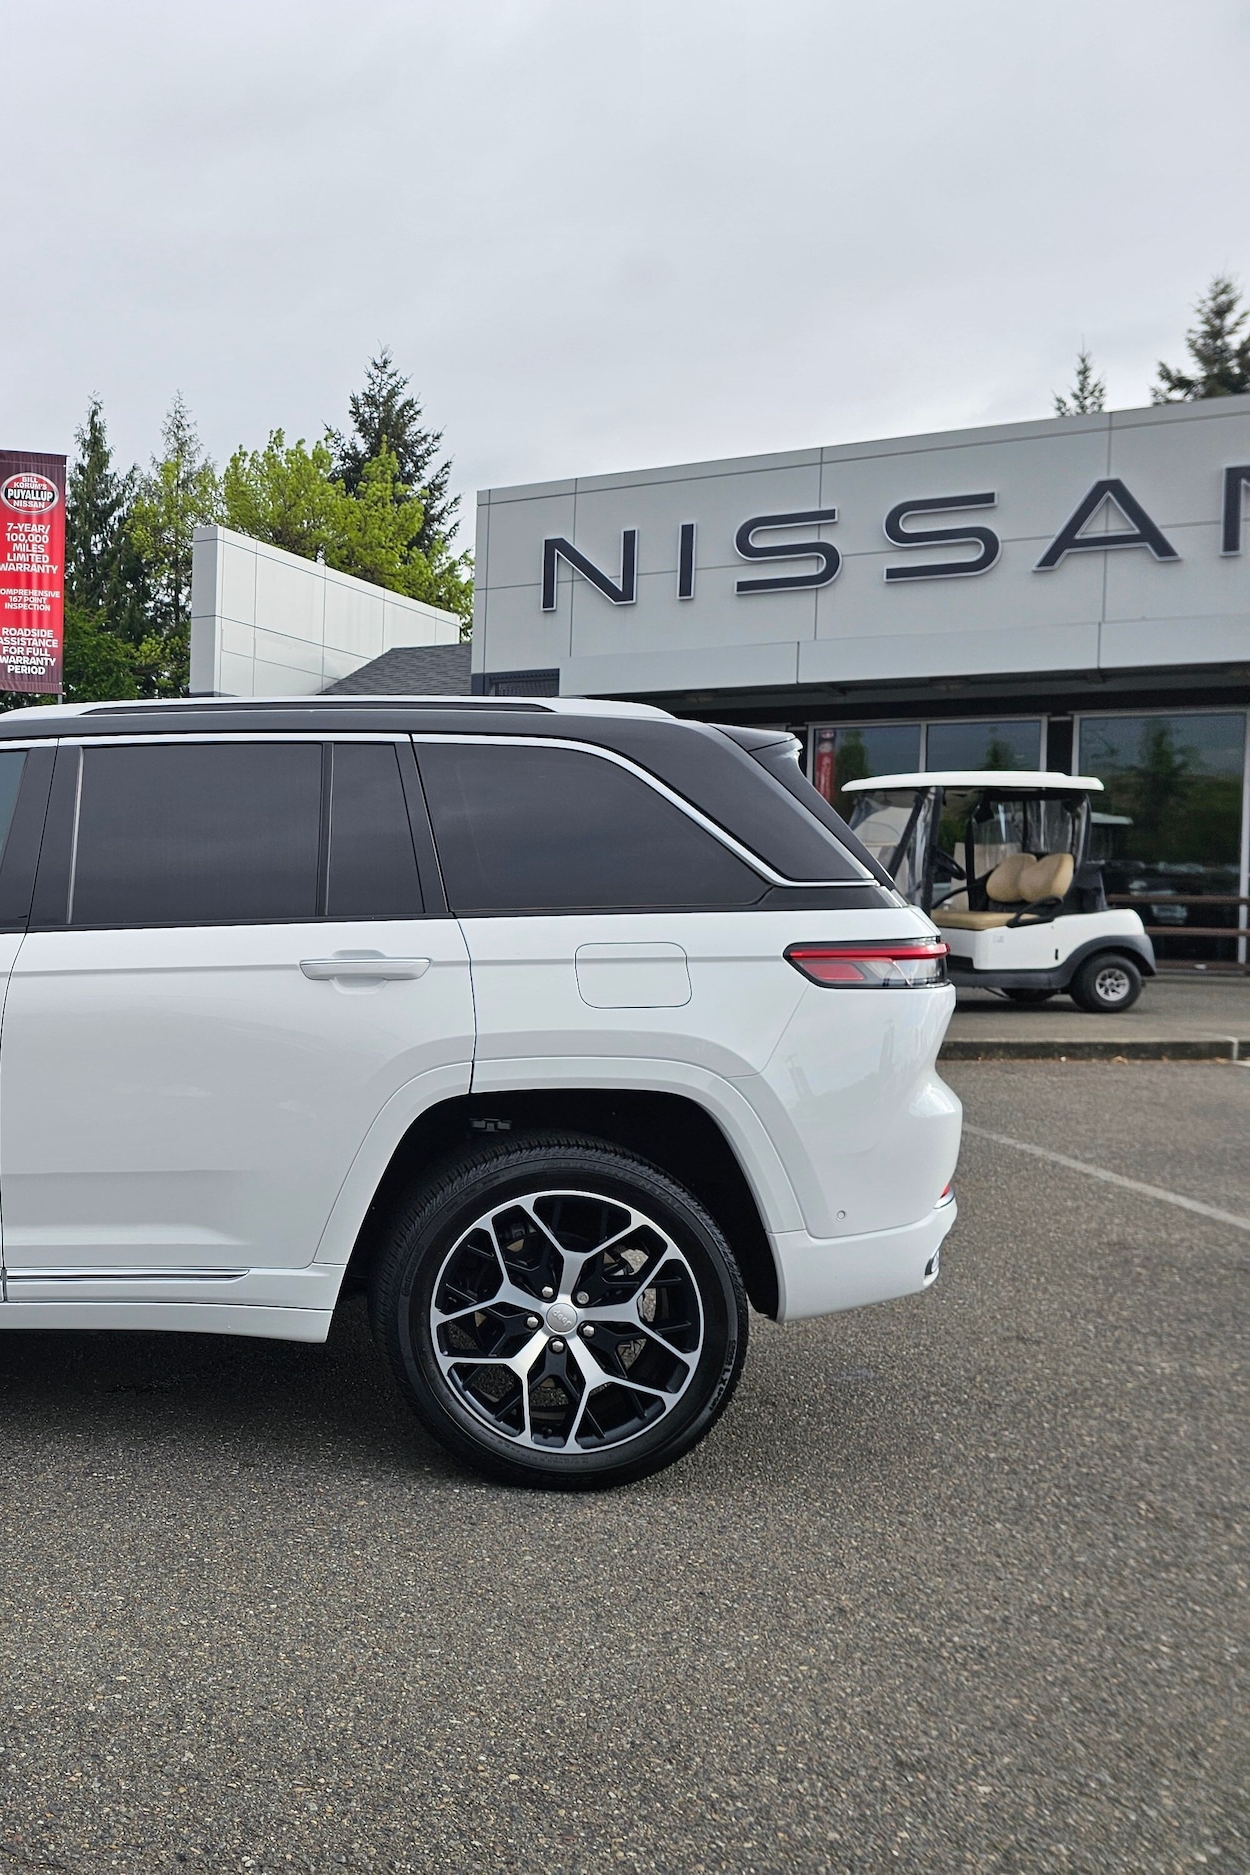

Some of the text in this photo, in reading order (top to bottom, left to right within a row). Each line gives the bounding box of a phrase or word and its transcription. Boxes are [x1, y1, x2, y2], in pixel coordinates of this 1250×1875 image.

[13, 482, 47, 490] KORUM'S
[7, 488, 53, 501] PUYALLUP
[13, 500, 45, 508] NISSAN
[7, 522, 50, 535] 7-YEAR/
[5, 532, 49, 544] 100,000
[541, 464, 1250, 612] NISSA
[12, 543, 45, 553] MILES
[7, 553, 49, 564] LIMITED
[23, 596, 47, 604] POINT
[5, 602, 50, 611] INSPECTION
[2, 627, 53, 638] ROADSIDE
[2, 646, 50, 657] FOR FULL
[0, 655, 56, 666] WARRANTY
[7, 665, 45, 675] PERIOD
[551, 1310, 573, 1327] Jeep
